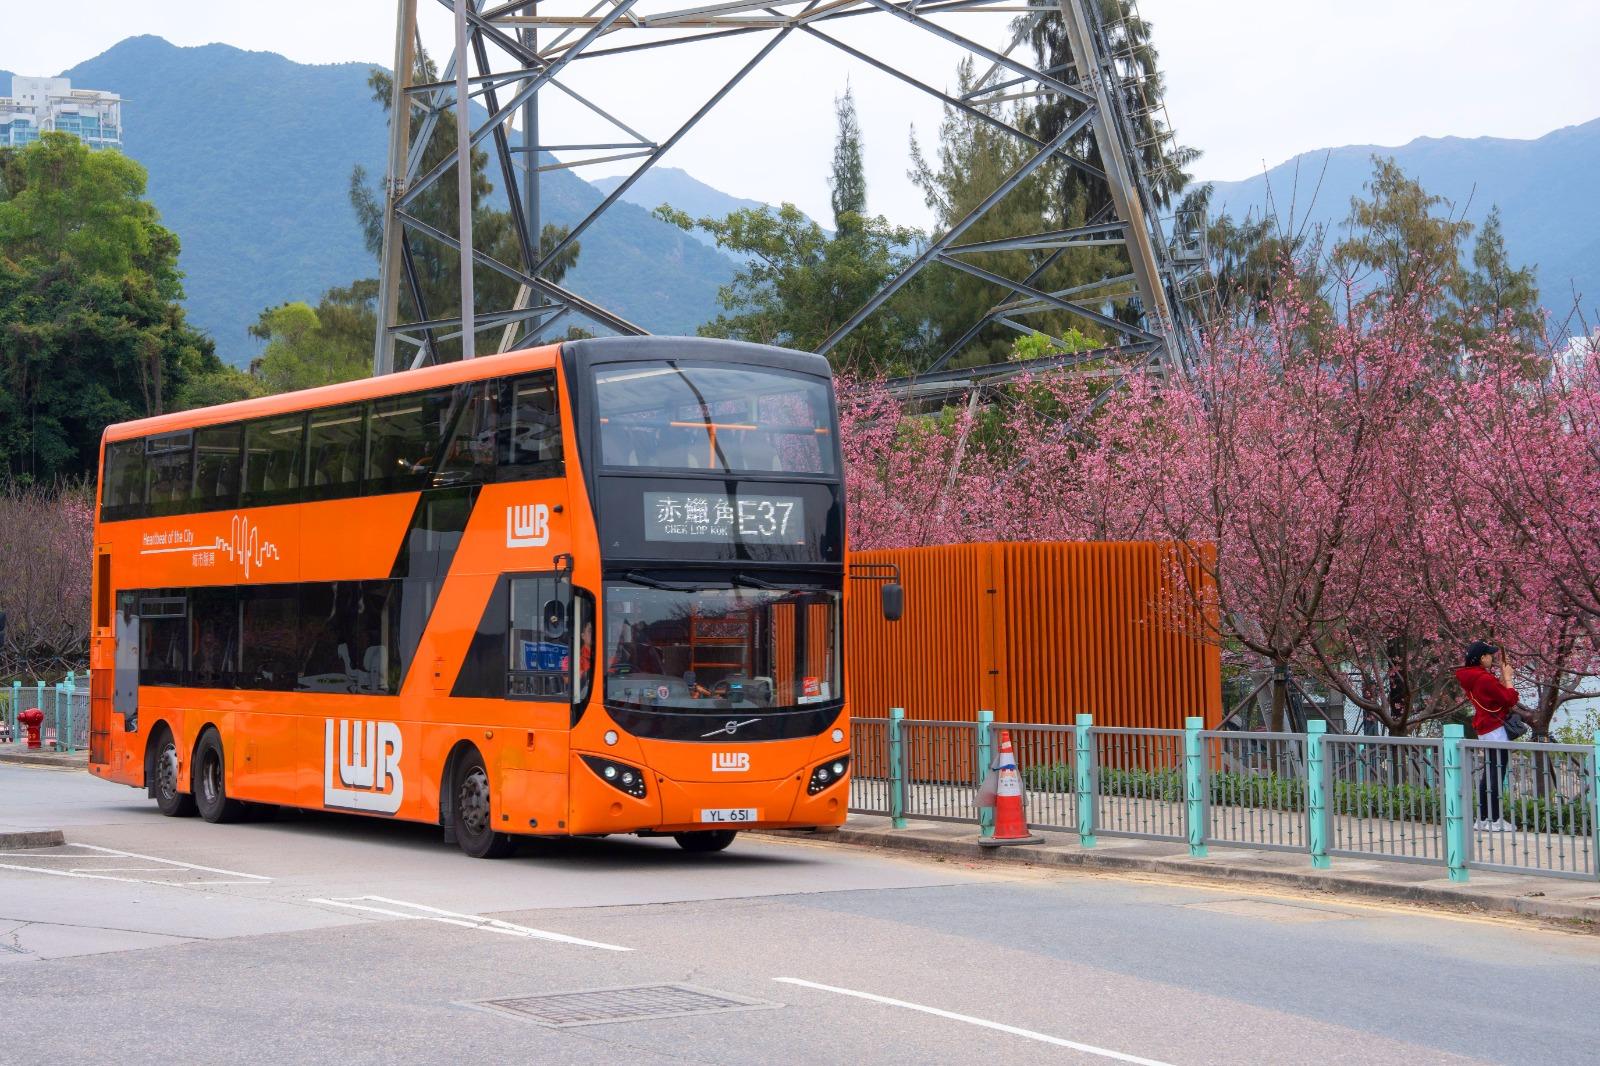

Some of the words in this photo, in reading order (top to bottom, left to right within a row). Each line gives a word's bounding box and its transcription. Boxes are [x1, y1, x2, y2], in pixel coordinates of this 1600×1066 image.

[506, 503, 550, 548] LWB
[738, 500, 794, 536] E37
[143, 531, 167, 545] Heartbeat
[174, 529, 183, 543] the
[183, 528, 194, 546] City
[690, 525, 708, 536] LAP
[324, 718, 403, 815] LWB
[711, 752, 750, 772] LWB
[709, 810, 724, 821] YL
[730, 809, 749, 821] 651
